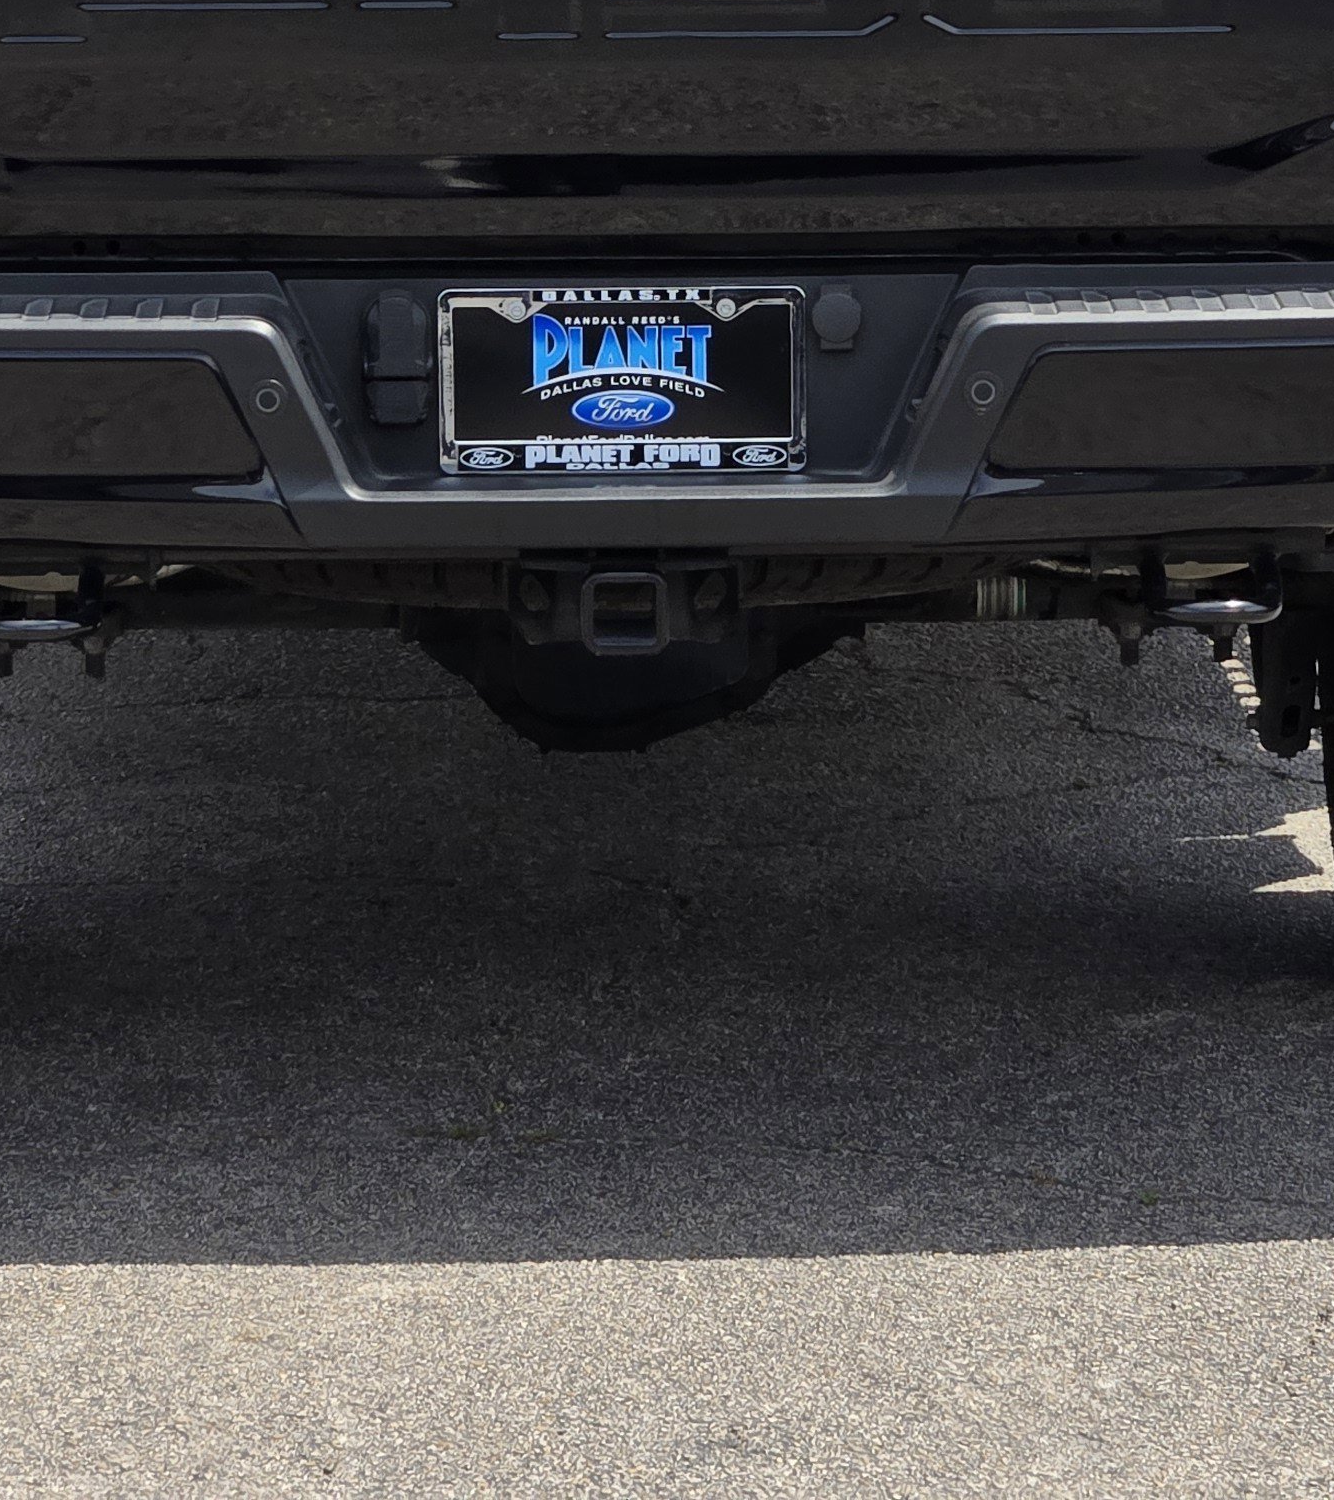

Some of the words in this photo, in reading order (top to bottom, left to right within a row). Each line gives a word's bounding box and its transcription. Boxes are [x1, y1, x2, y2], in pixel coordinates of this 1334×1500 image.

[564, 316, 626, 325] RANDALL
[532, 313, 712, 388] PLANET
[540, 378, 603, 400] DALLAS
[610, 375, 653, 387] LOVE
[659, 378, 706, 399] FIELD
[591, 395, 655, 422] Ford
[468, 449, 505, 466] Ford
[525, 444, 635, 469] PLANET
[643, 443, 721, 467] FORD
[741, 448, 778, 465] Ford
